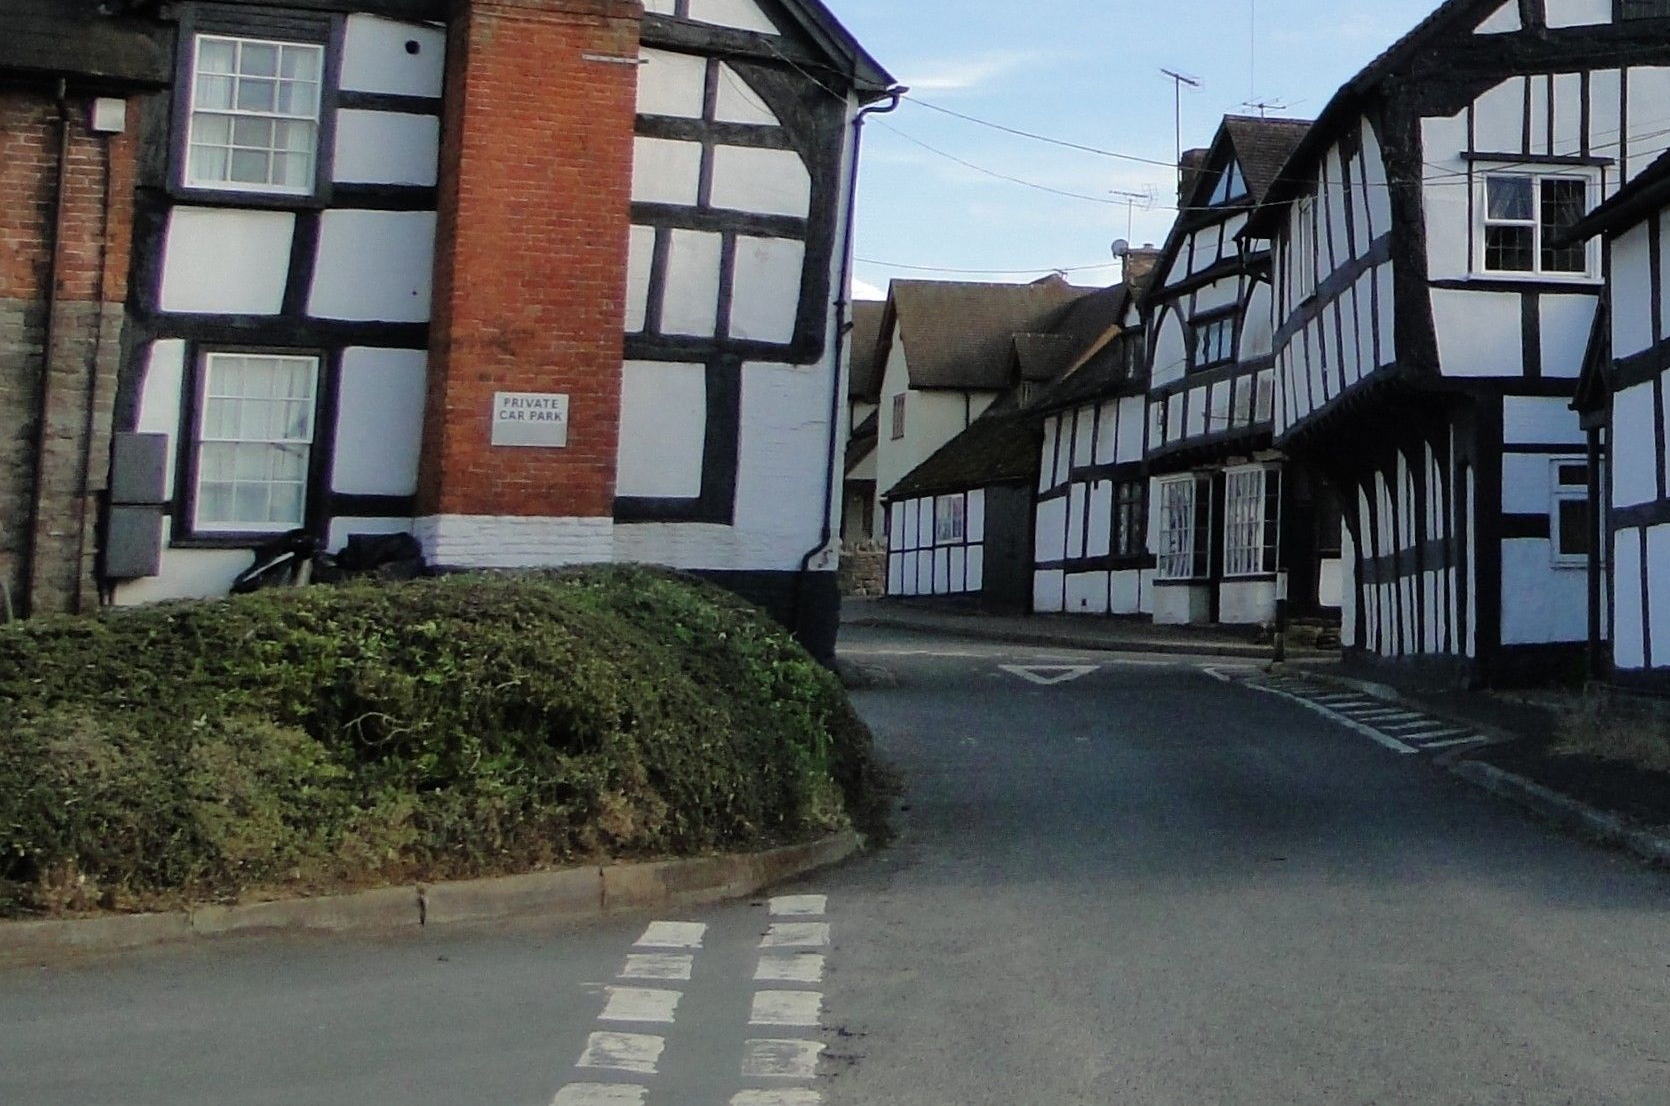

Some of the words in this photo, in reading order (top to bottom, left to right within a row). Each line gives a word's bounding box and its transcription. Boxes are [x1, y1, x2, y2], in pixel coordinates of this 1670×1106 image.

[503, 397, 559, 409] PRIVATE
[499, 410, 525, 421] CAR
[529, 410, 562, 422] PARK
